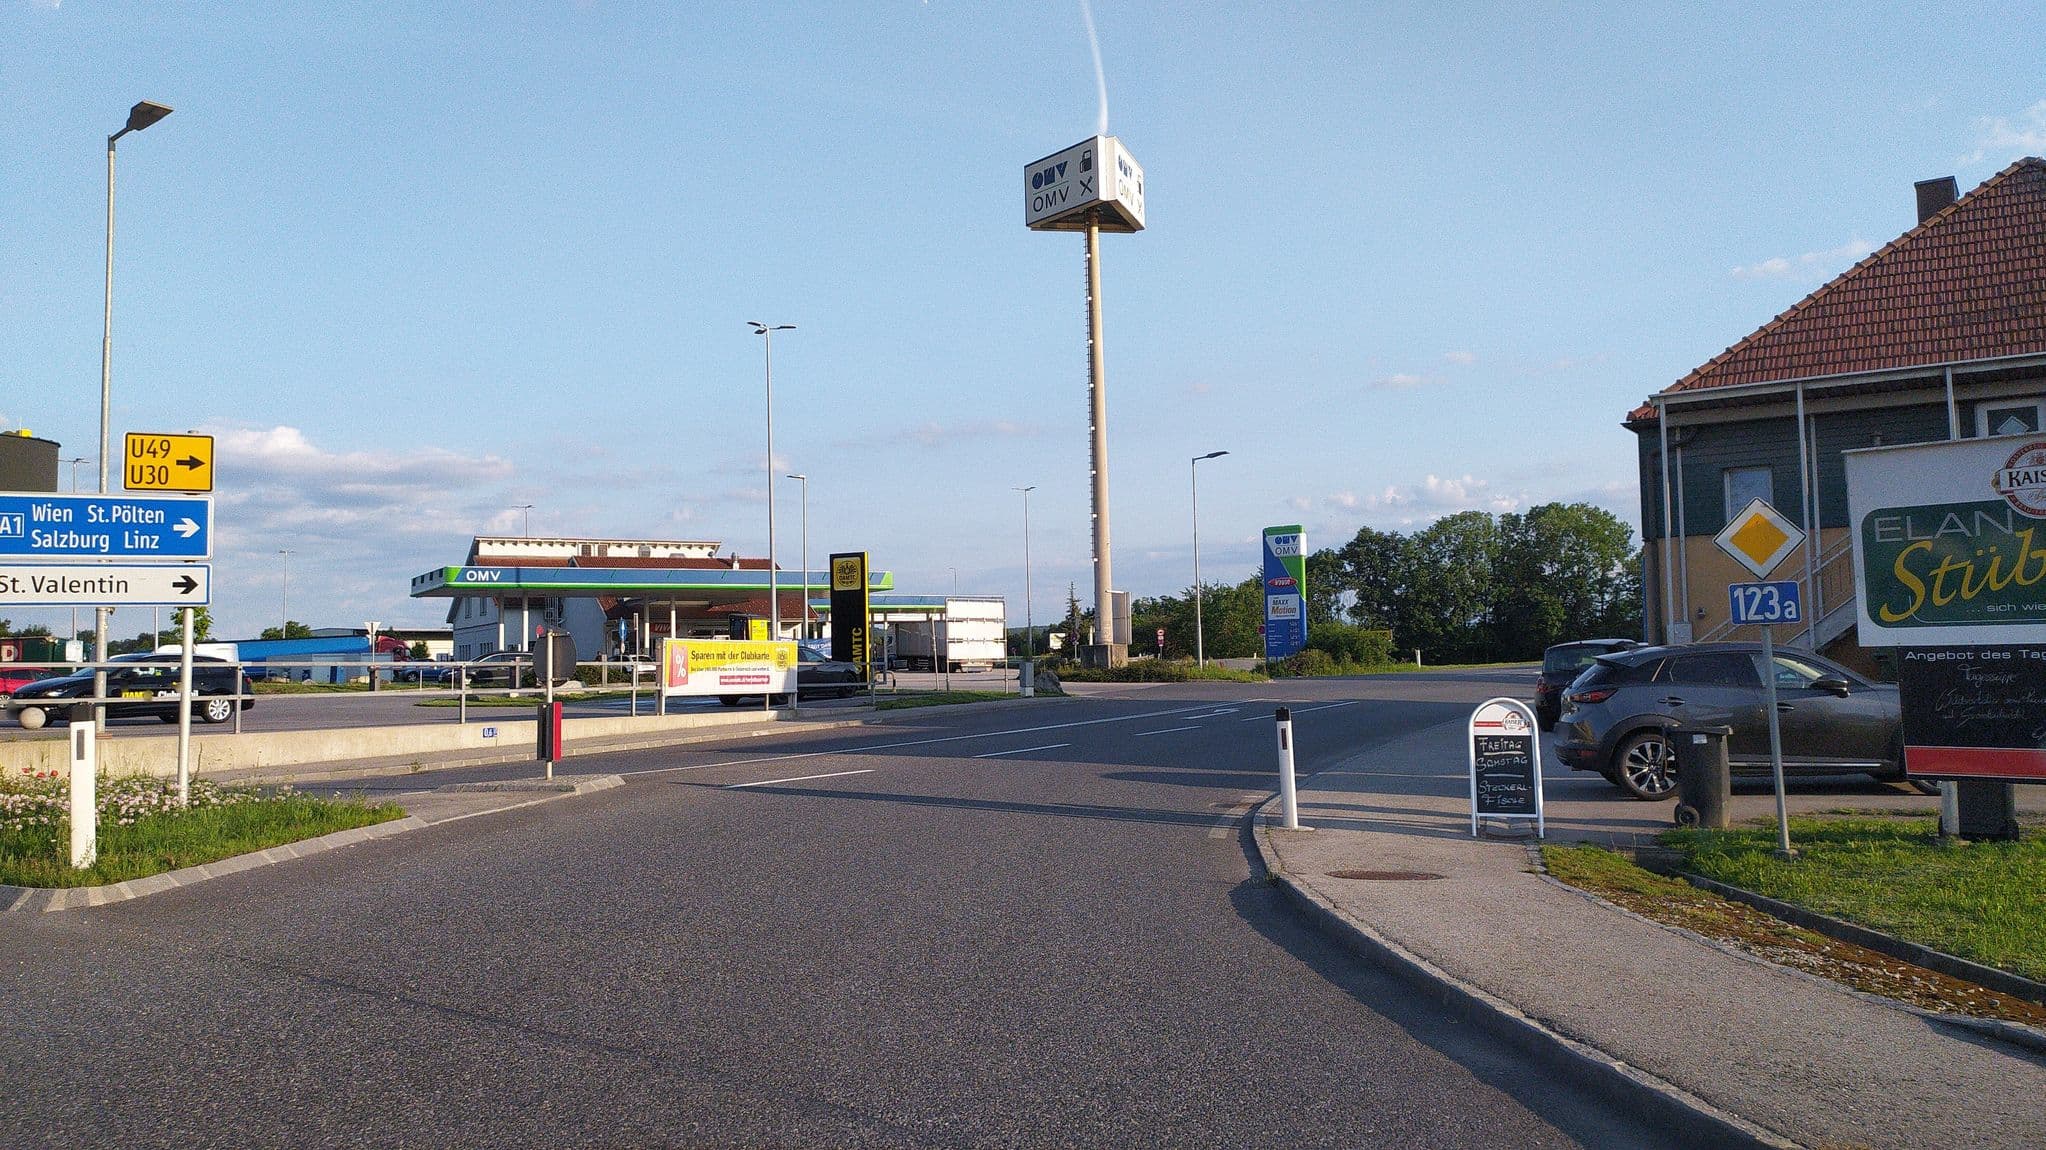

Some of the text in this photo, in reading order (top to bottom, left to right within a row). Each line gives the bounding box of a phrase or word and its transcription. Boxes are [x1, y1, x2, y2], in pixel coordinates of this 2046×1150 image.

[1033, 186, 1069, 212] OMV
[131, 439, 171, 459] U49
[130, 465, 169, 485] U30
[32, 503, 73, 523] Wien
[112, 504, 165, 524] Pölten
[0, 516, 22, 535] A1
[1874, 508, 2014, 543] ELAN
[31, 529, 160, 553] Salzburg Linz
[1275, 546, 1298, 556] OMV
[0, 575, 128, 594] St. Valentin
[466, 570, 501, 582] OMV
[1879, 527, 2046, 623] Stüb
[1271, 605, 1297, 615] Motion
[1733, 585, 1798, 621] 123a
[1986, 602, 2017, 613] sich
[2022, 602, 2046, 612] wie
[691, 650, 715, 662] Sparen
[716, 651, 726, 660] mit
[728, 651, 739, 660] der
[741, 650, 770, 660] Clubkarte
[1905, 651, 1974, 662] Angebot
[1981, 650, 2011, 660] des
